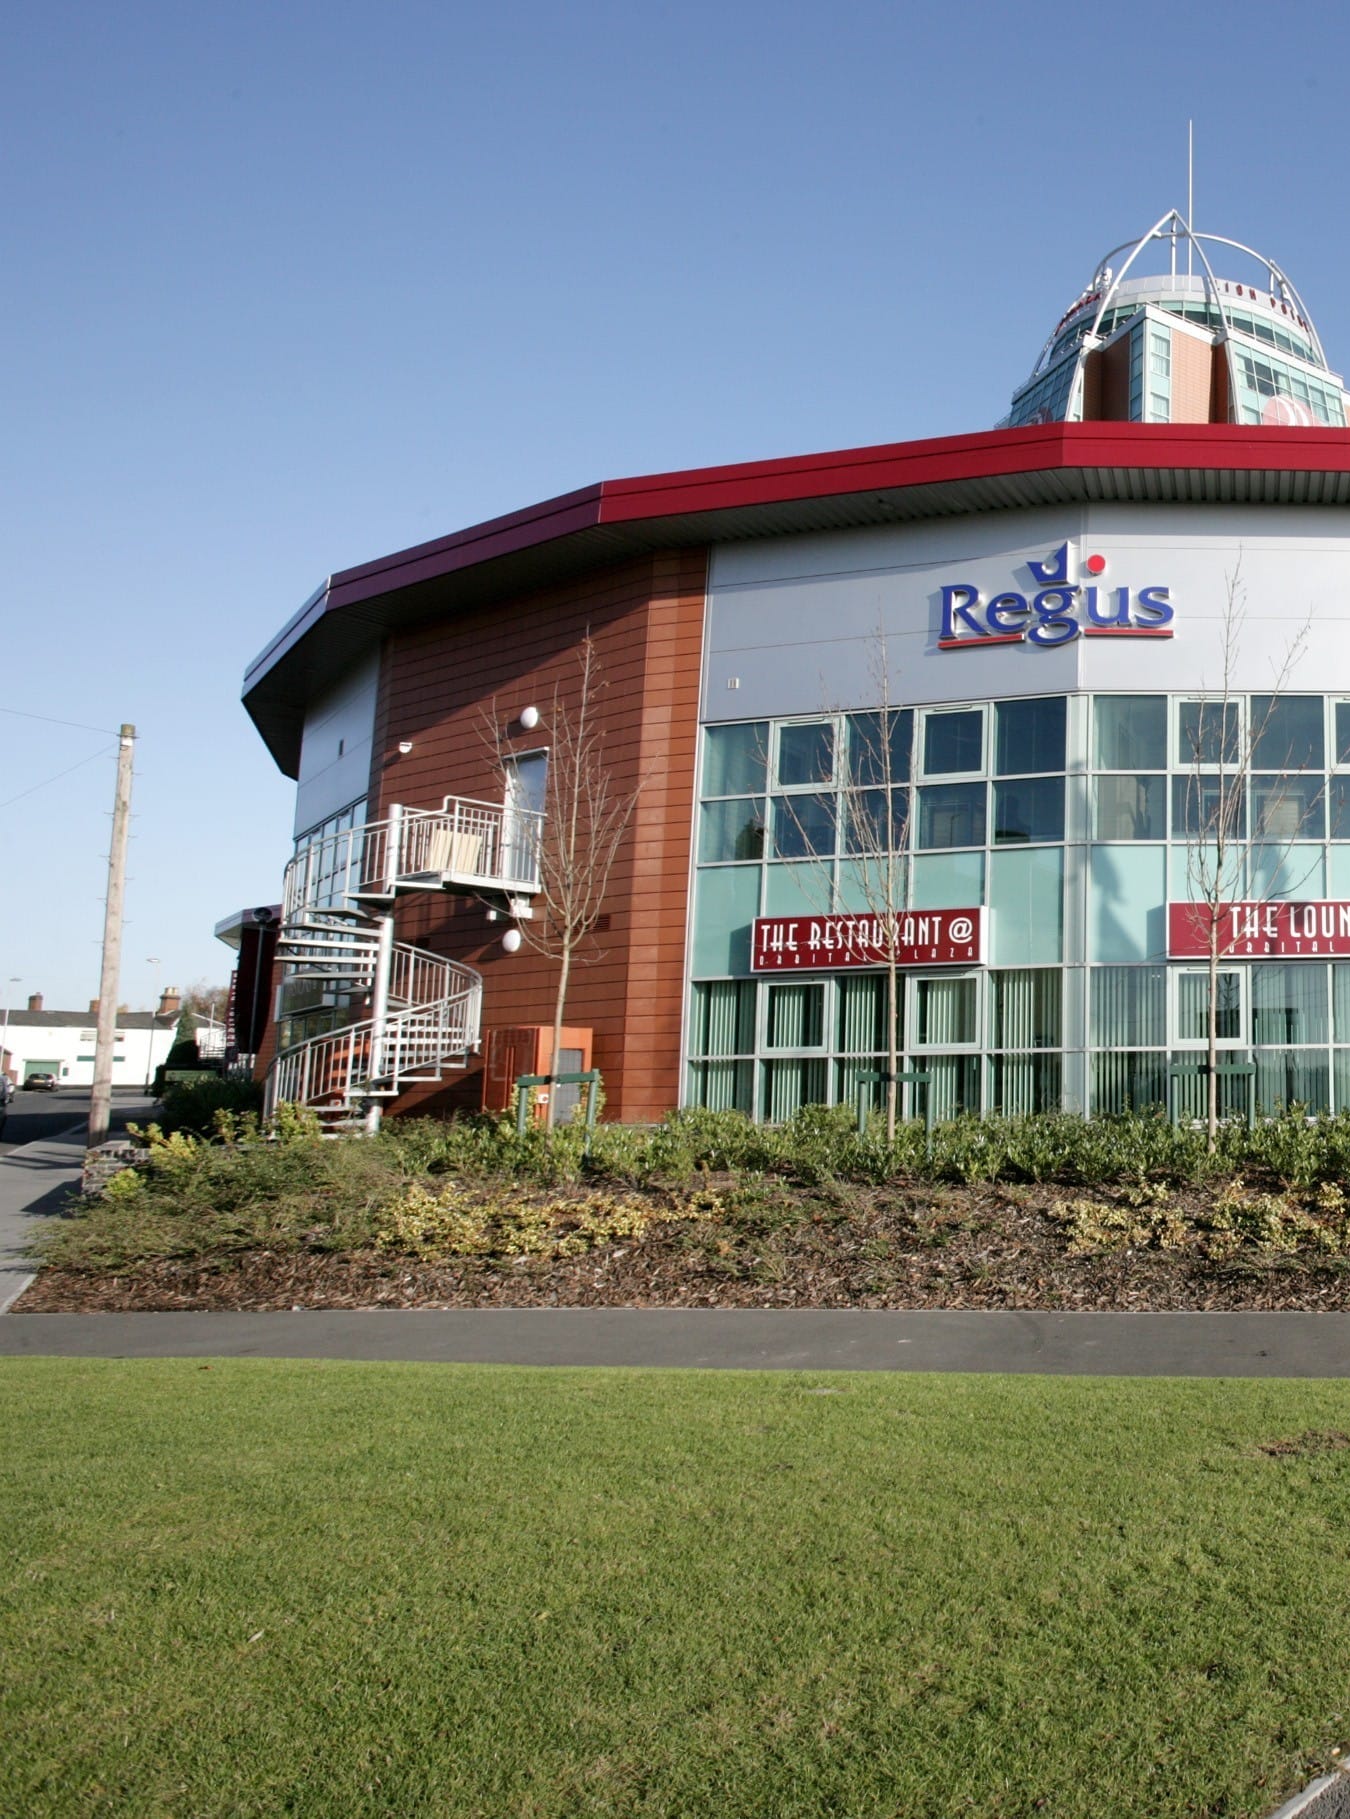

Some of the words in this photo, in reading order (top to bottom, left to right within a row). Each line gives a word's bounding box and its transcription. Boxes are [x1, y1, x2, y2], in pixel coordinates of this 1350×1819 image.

[939, 583, 1175, 646] Regus
[761, 923, 798, 952] THE
[949, 917, 973, 944] @
[1230, 906, 1278, 938] THE
